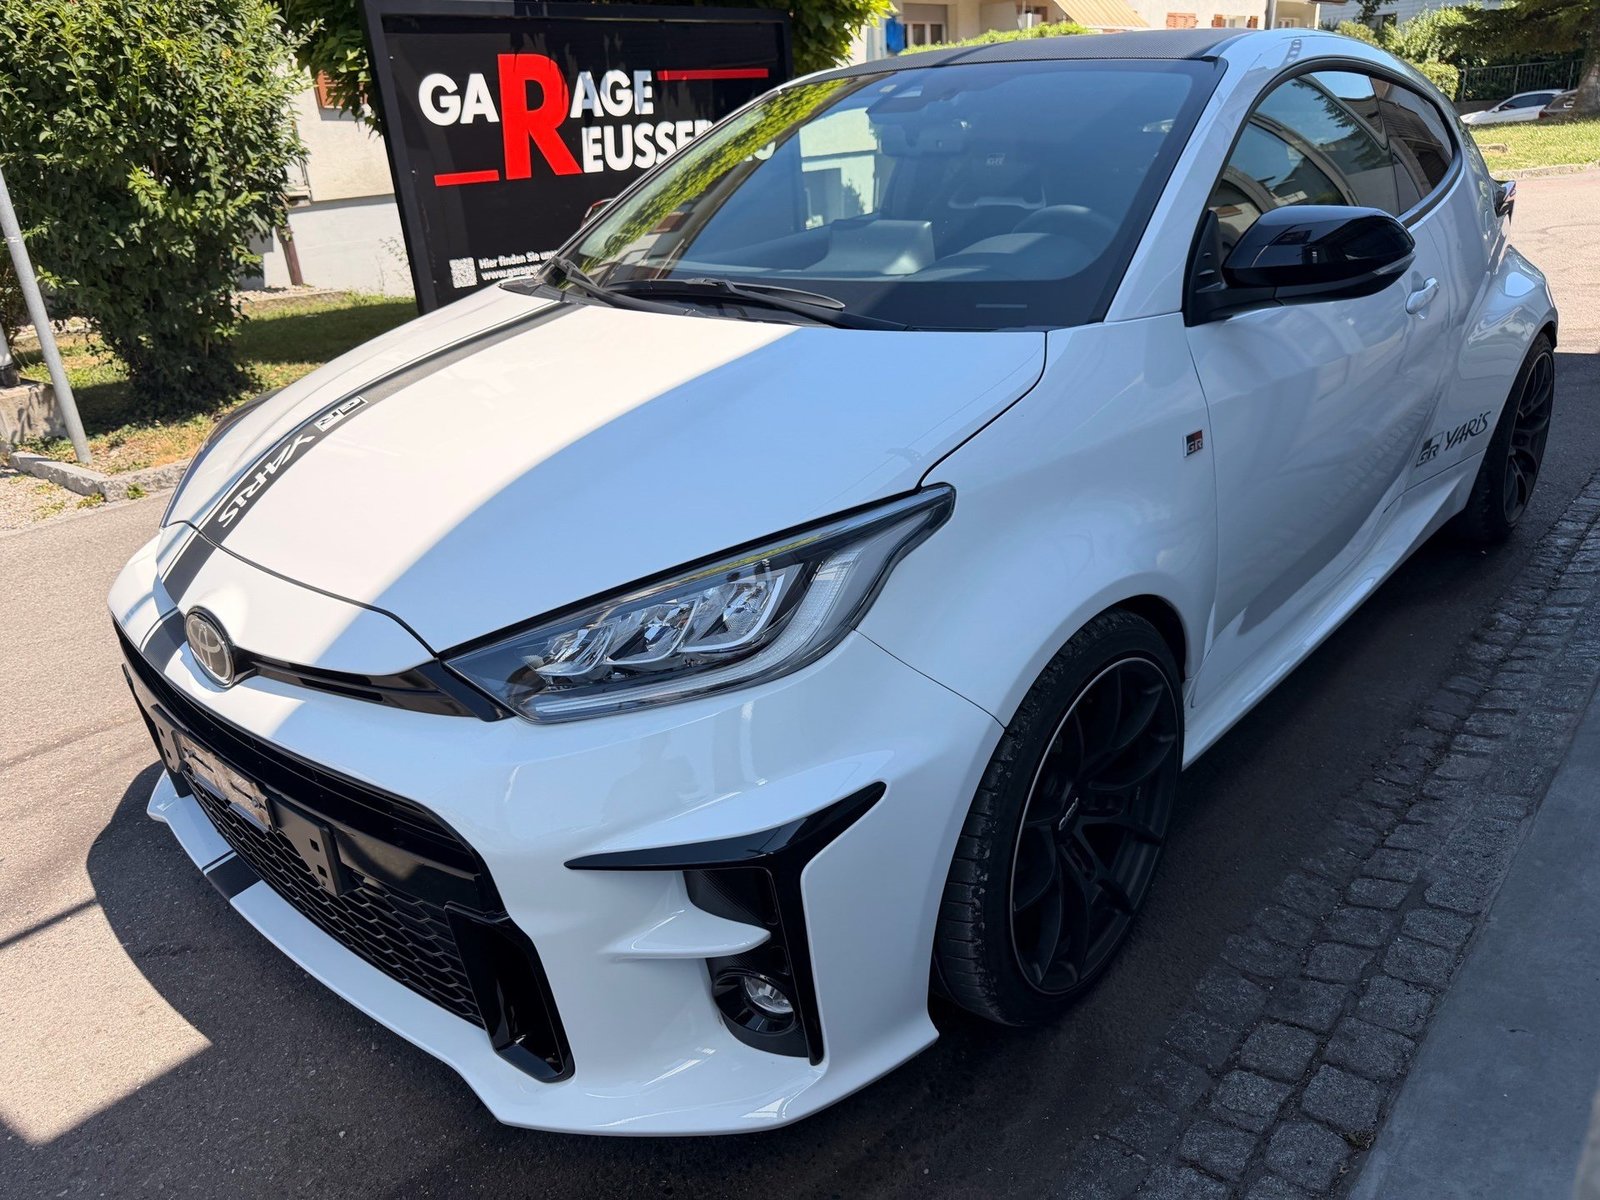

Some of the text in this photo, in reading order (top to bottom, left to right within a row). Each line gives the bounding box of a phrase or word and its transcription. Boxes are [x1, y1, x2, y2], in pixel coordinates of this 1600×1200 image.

[418, 53, 654, 180] GARAGE
[478, 257, 498, 270] Hier
[498, 253, 527, 267] finden
[526, 250, 540, 262] Sie
